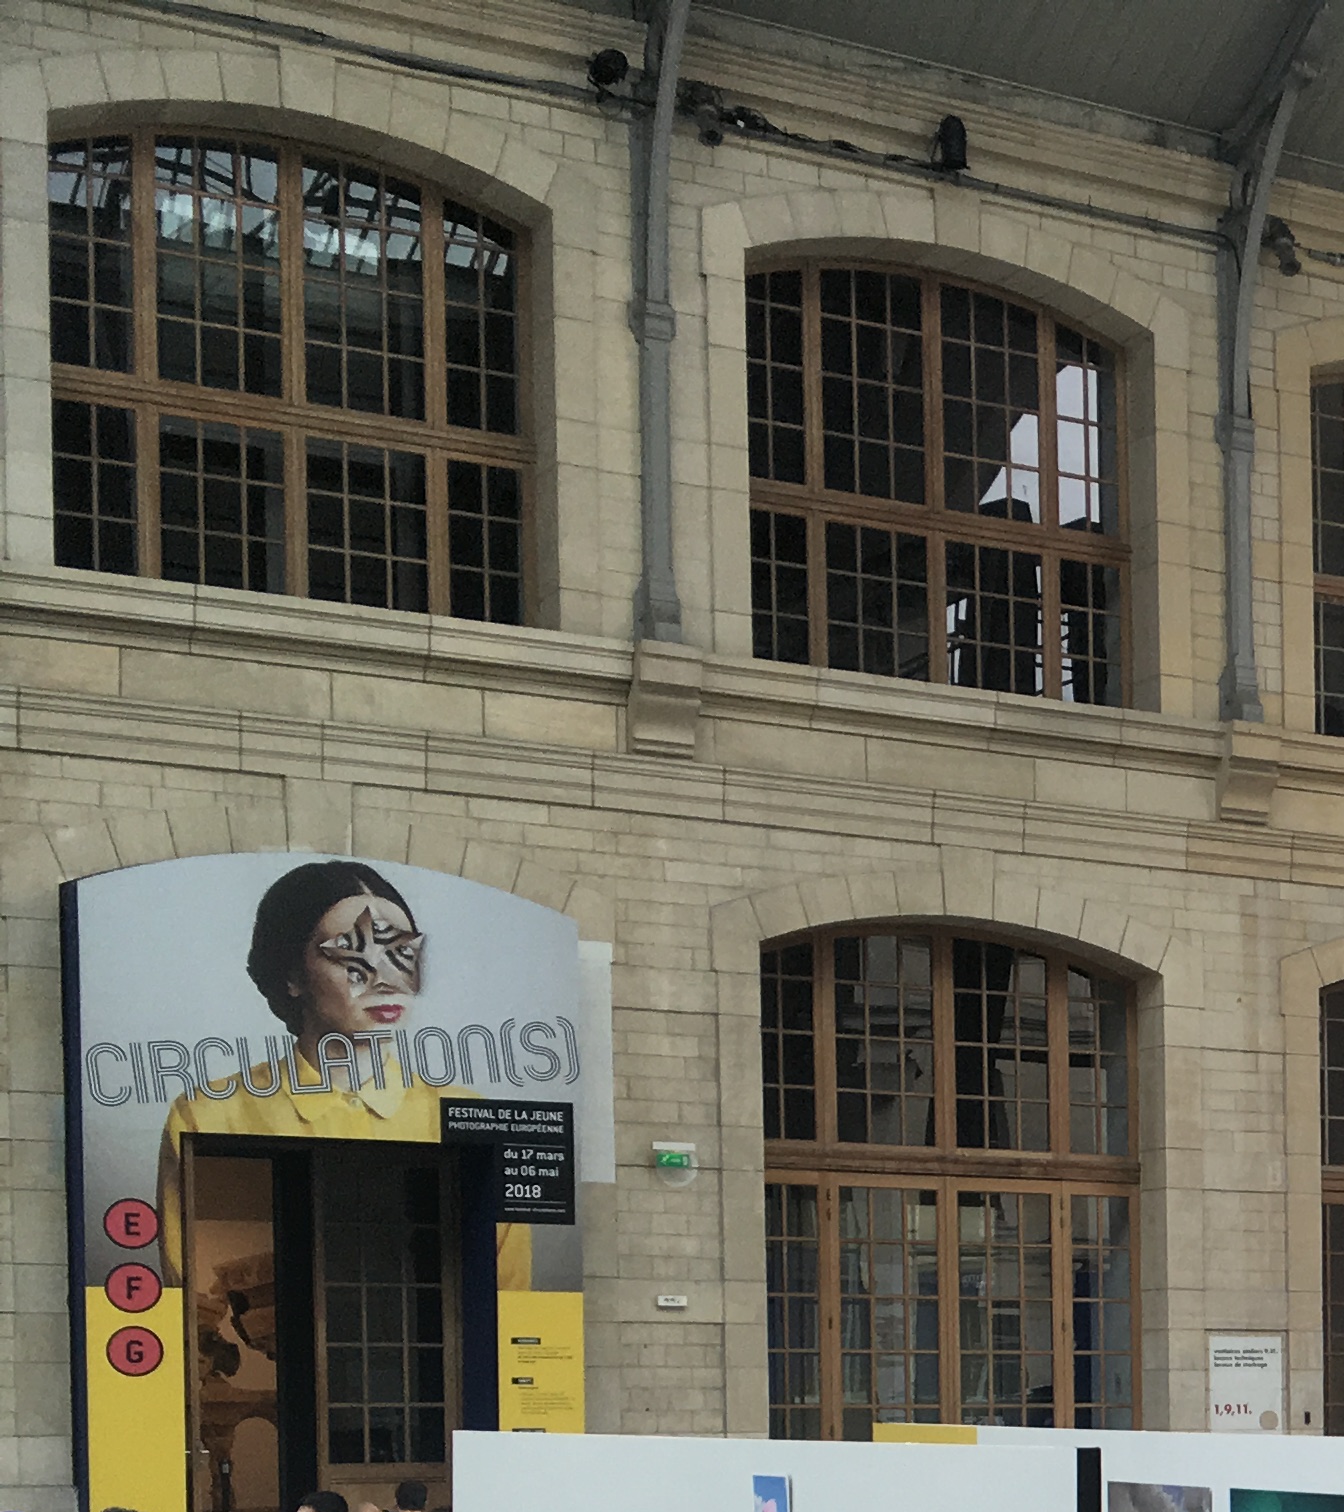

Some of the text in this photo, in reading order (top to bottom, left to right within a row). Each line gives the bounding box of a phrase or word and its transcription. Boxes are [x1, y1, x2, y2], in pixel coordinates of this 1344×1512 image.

[86, 1016, 580, 1106] CIRCULATION(S)
[448, 1107, 564, 1122] FESTIVAL DE LA JEUNE
[448, 1121, 564, 1134] PHOTOGRAPHIE EUROPÉENNE
[504, 1149, 565, 1161] du 17 mars
[504, 1165, 559, 1177] au 06 mai
[505, 1184, 541, 1198] 2018
[124, 1212, 141, 1236] E
[126, 1276, 142, 1300] F
[126, 1340, 144, 1363] G
